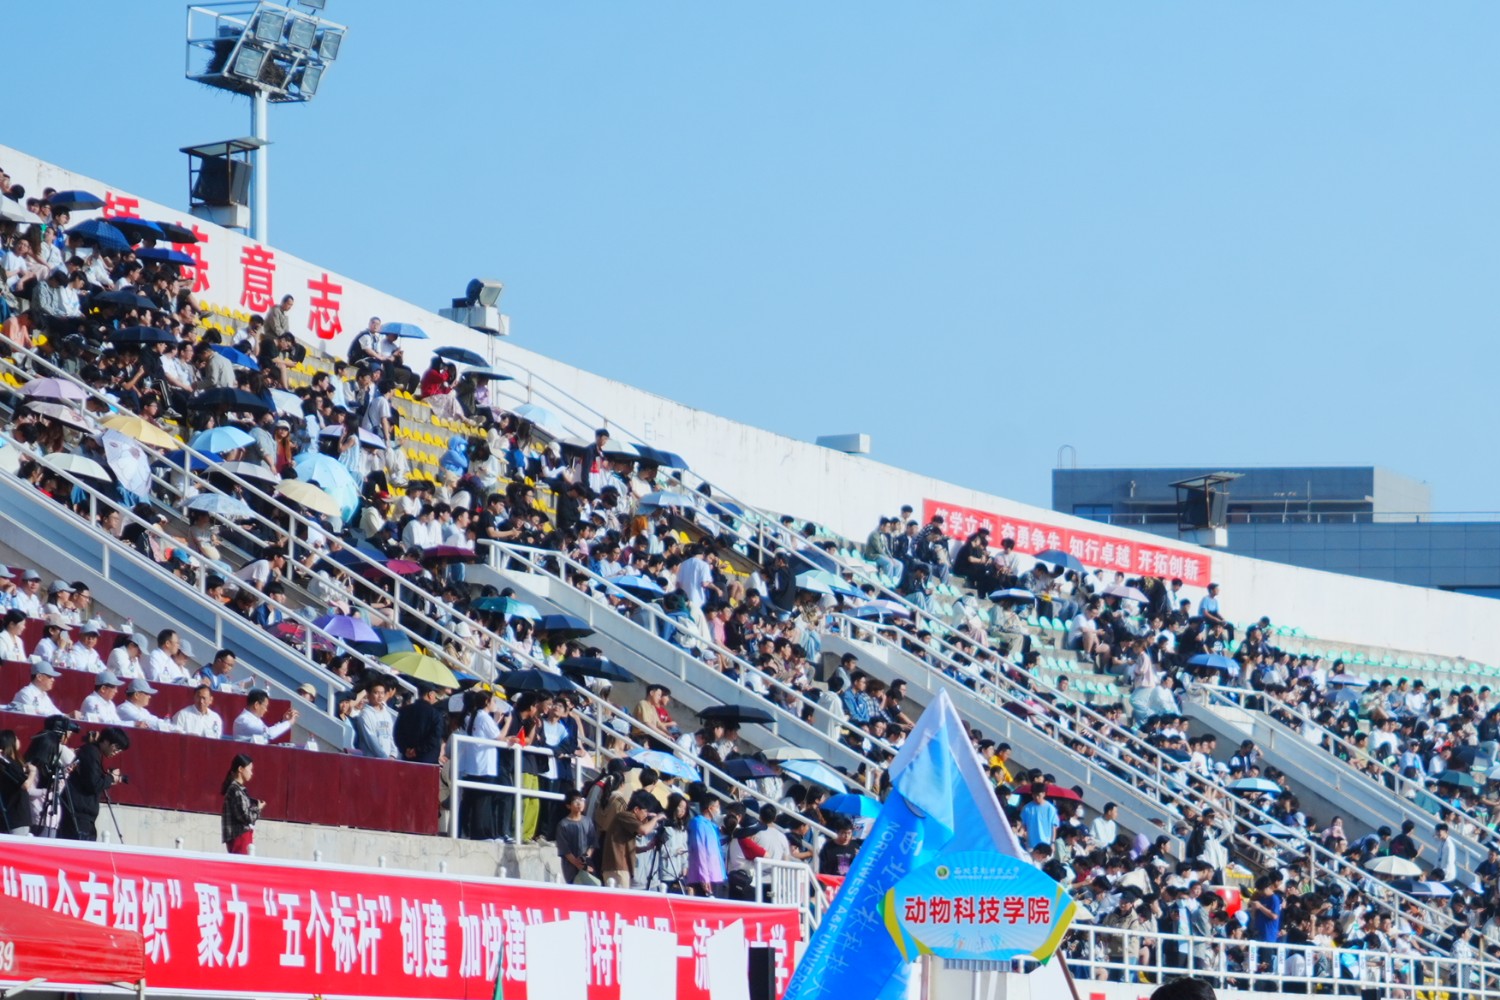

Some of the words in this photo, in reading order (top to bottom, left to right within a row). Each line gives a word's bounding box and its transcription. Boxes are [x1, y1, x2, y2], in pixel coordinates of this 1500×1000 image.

[1069, 536, 1131, 568] 知行卓越
[1138, 549, 1200, 580] 开拓创新
[843, 821, 900, 904] NORTHWEST
[194, 882, 250, 968] 聚力
[904, 895, 1051, 925] 动物科技学院
